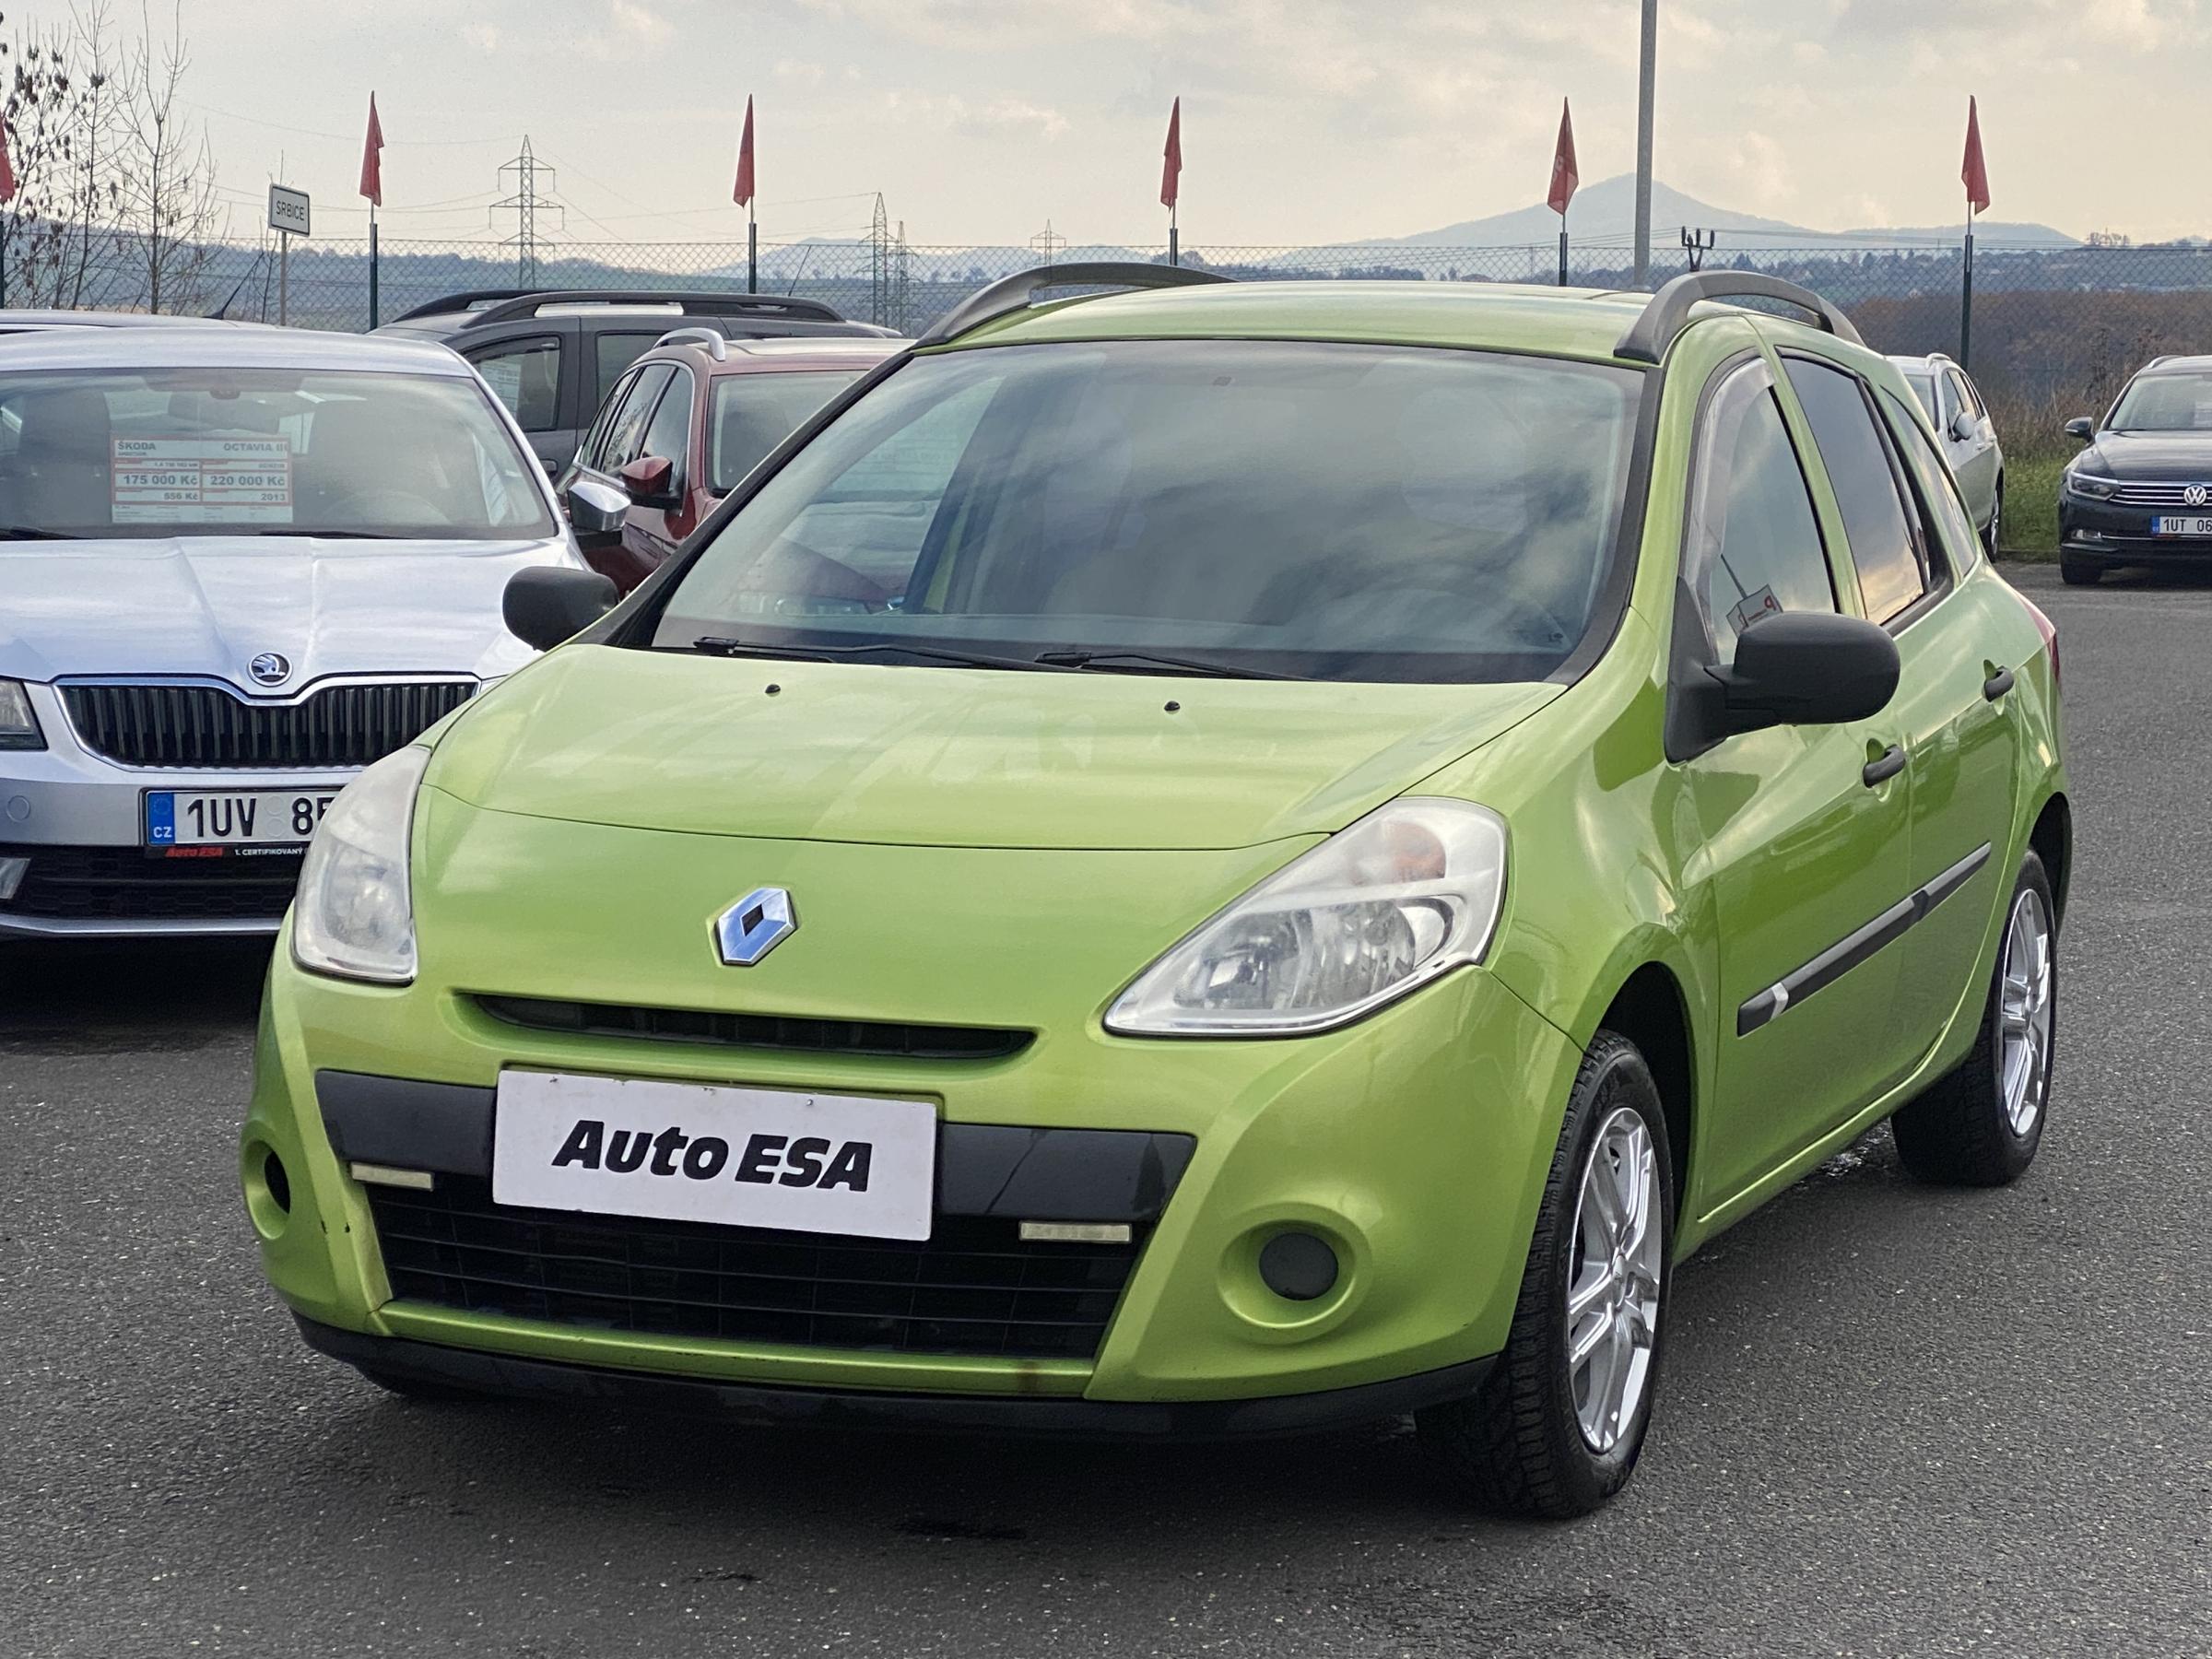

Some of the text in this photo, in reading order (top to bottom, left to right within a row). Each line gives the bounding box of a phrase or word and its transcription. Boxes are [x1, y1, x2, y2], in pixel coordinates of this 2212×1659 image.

[276, 200, 305, 221] SRBICE
[117, 441, 157, 451] ŠKODA
[223, 442, 273, 452] OCTAVIA
[124, 475, 198, 485] 175 000 Kč
[209, 476, 234, 486] 220
[238, 476, 263, 486] 000
[2163, 518, 2212, 532] 1UT 06
[187, 797, 257, 838] 1UV
[153, 826, 172, 839] CZ
[241, 846, 303, 856] CERTIFIKOVANÝ
[551, 1119, 873, 1193] Auto ESA
